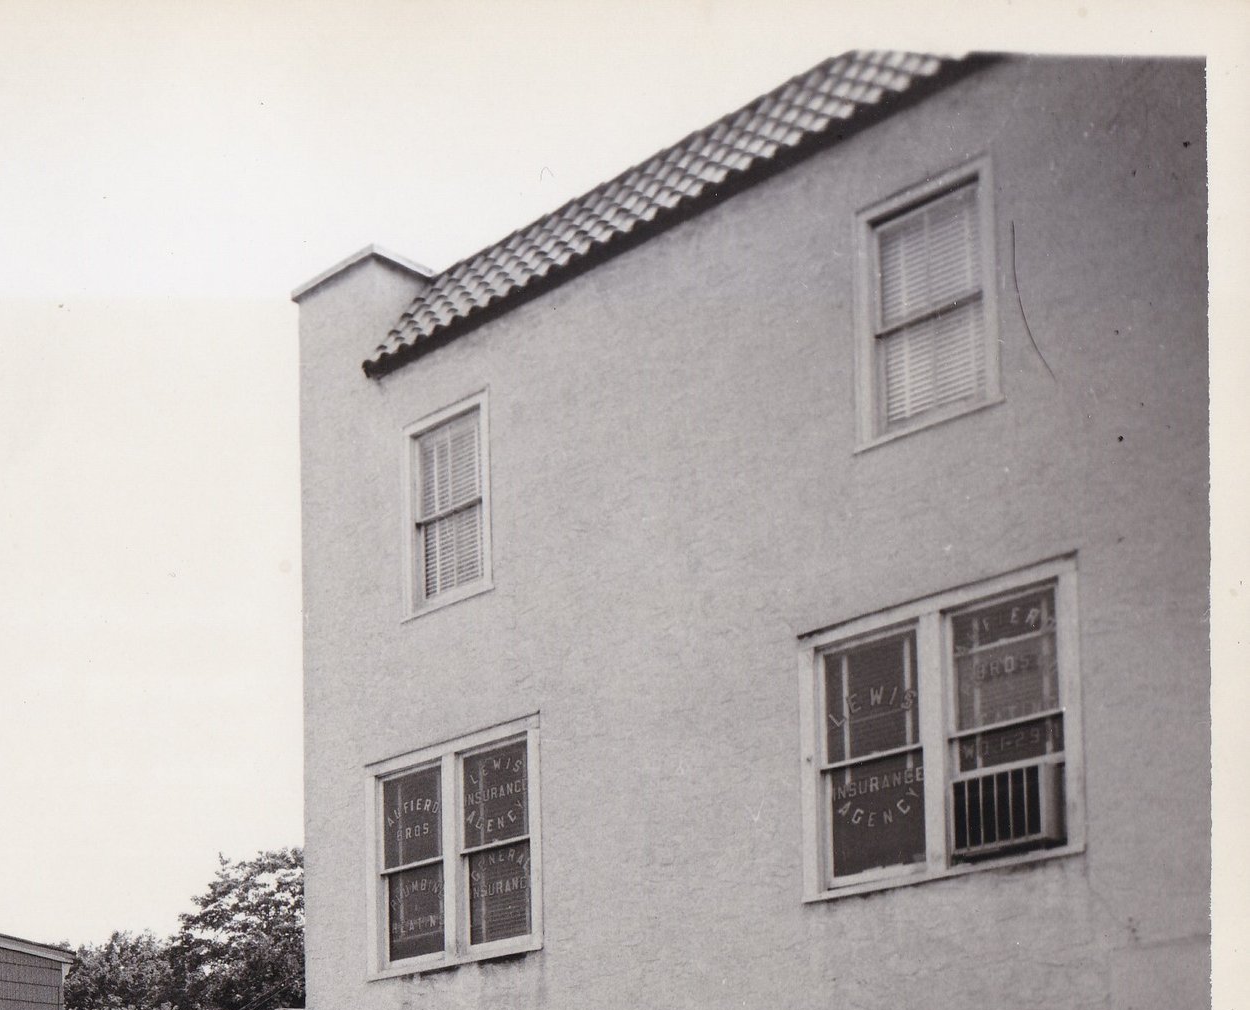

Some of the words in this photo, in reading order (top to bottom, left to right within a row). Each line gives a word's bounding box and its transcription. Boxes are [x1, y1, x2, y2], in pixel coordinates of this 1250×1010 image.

[828, 686, 918, 728] LEWIS
[470, 758, 523, 785] LEWIS
[832, 766, 924, 801] INSURANCE
[464, 778, 527, 806] INSURANCE
[838, 786, 919, 827] AGENCY
[396, 822, 430, 842] BROS
[466, 800, 524, 833] AGENCY
[471, 848, 531, 882] GENERAL
